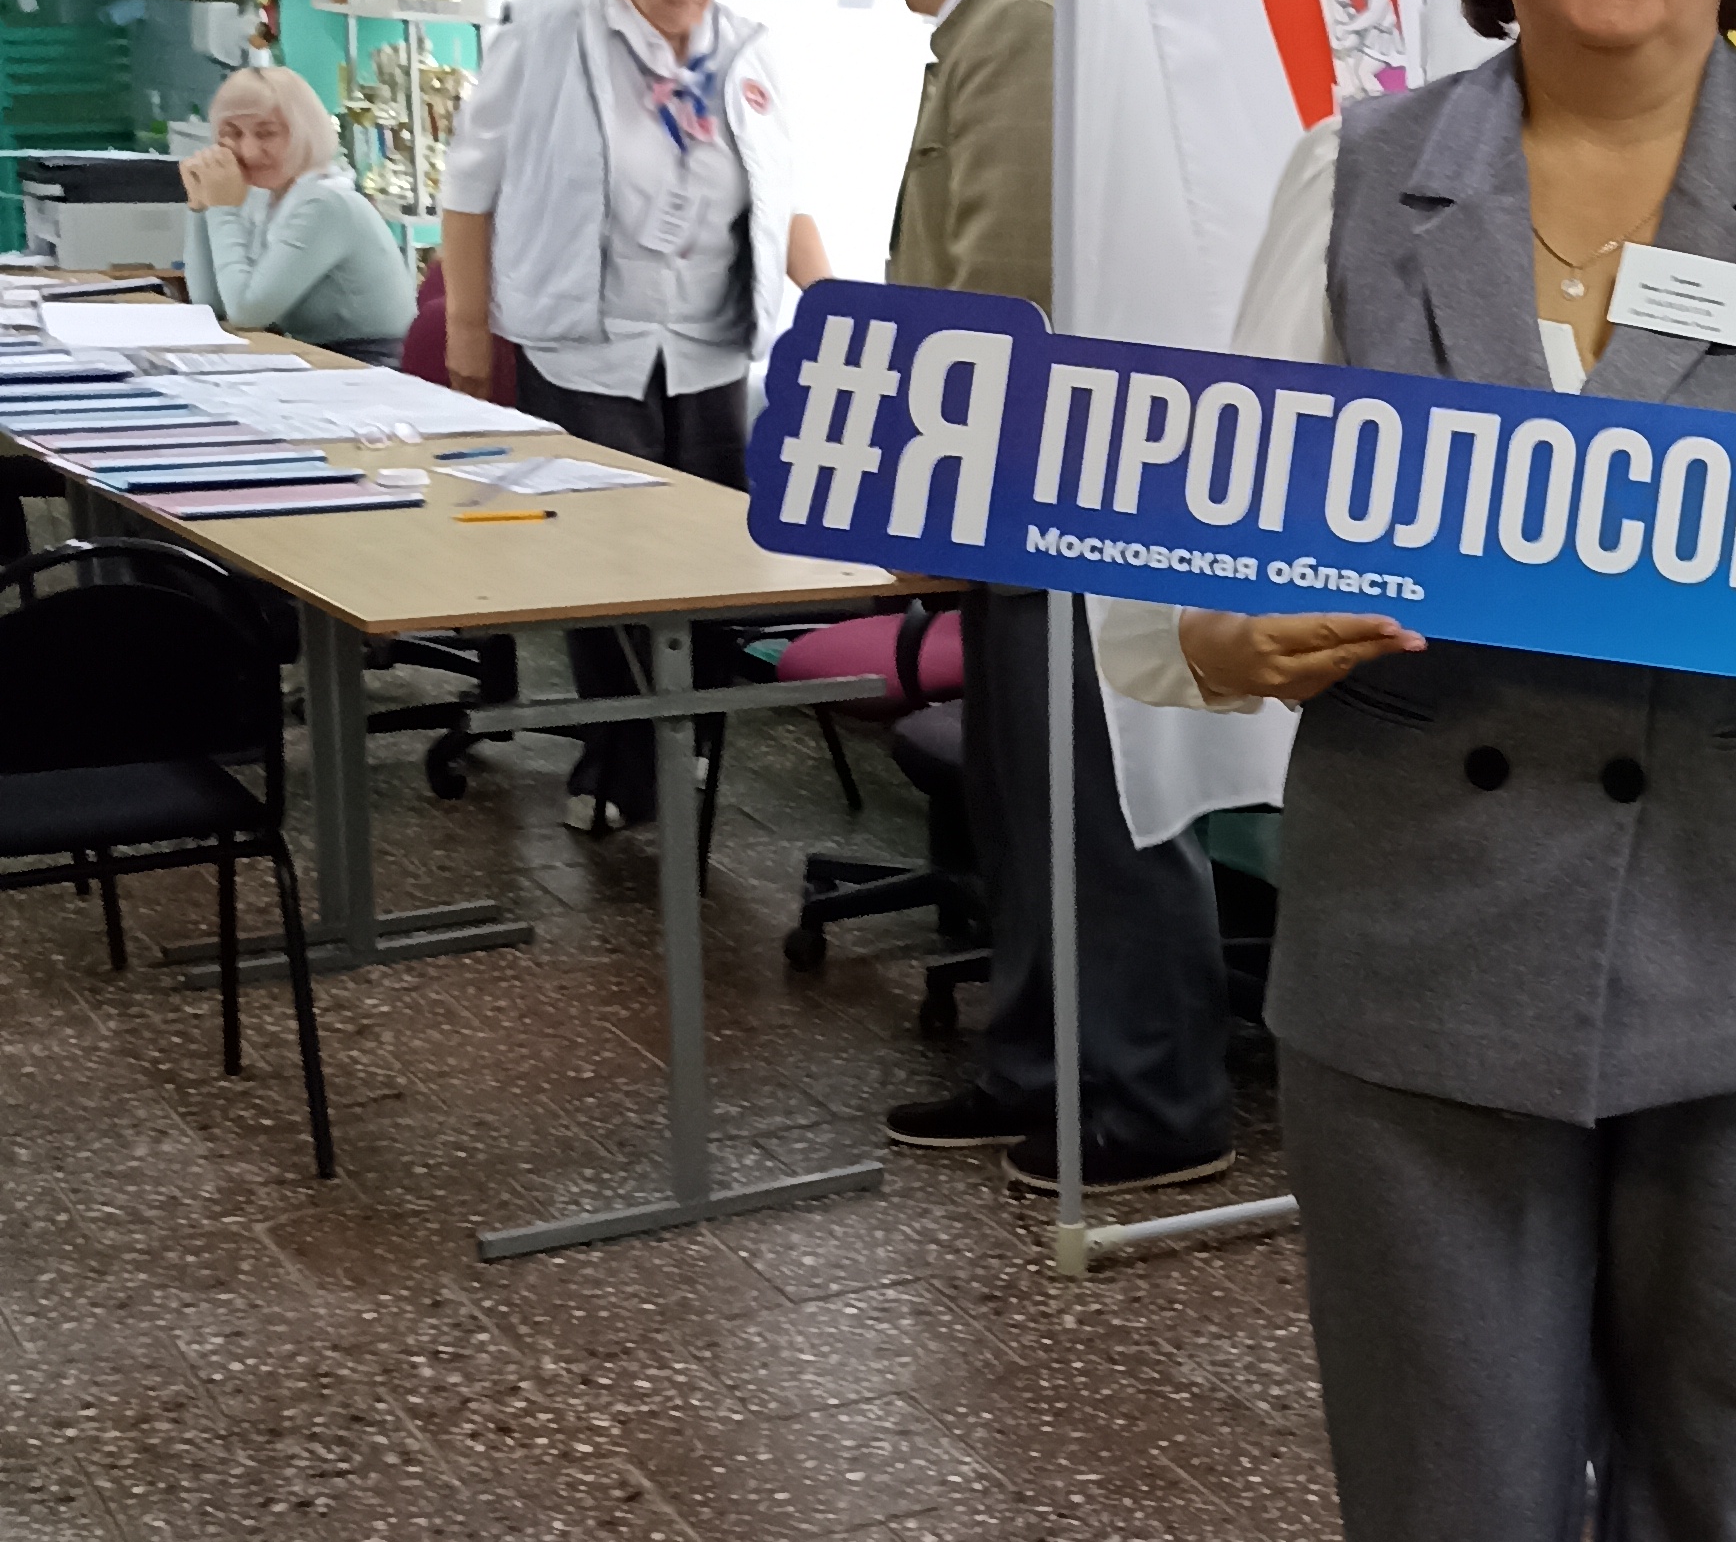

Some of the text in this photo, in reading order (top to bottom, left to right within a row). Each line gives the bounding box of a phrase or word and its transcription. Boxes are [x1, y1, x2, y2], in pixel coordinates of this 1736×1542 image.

[780, 315, 1014, 547] #Я
[1026, 524, 1425, 602] Московская область
